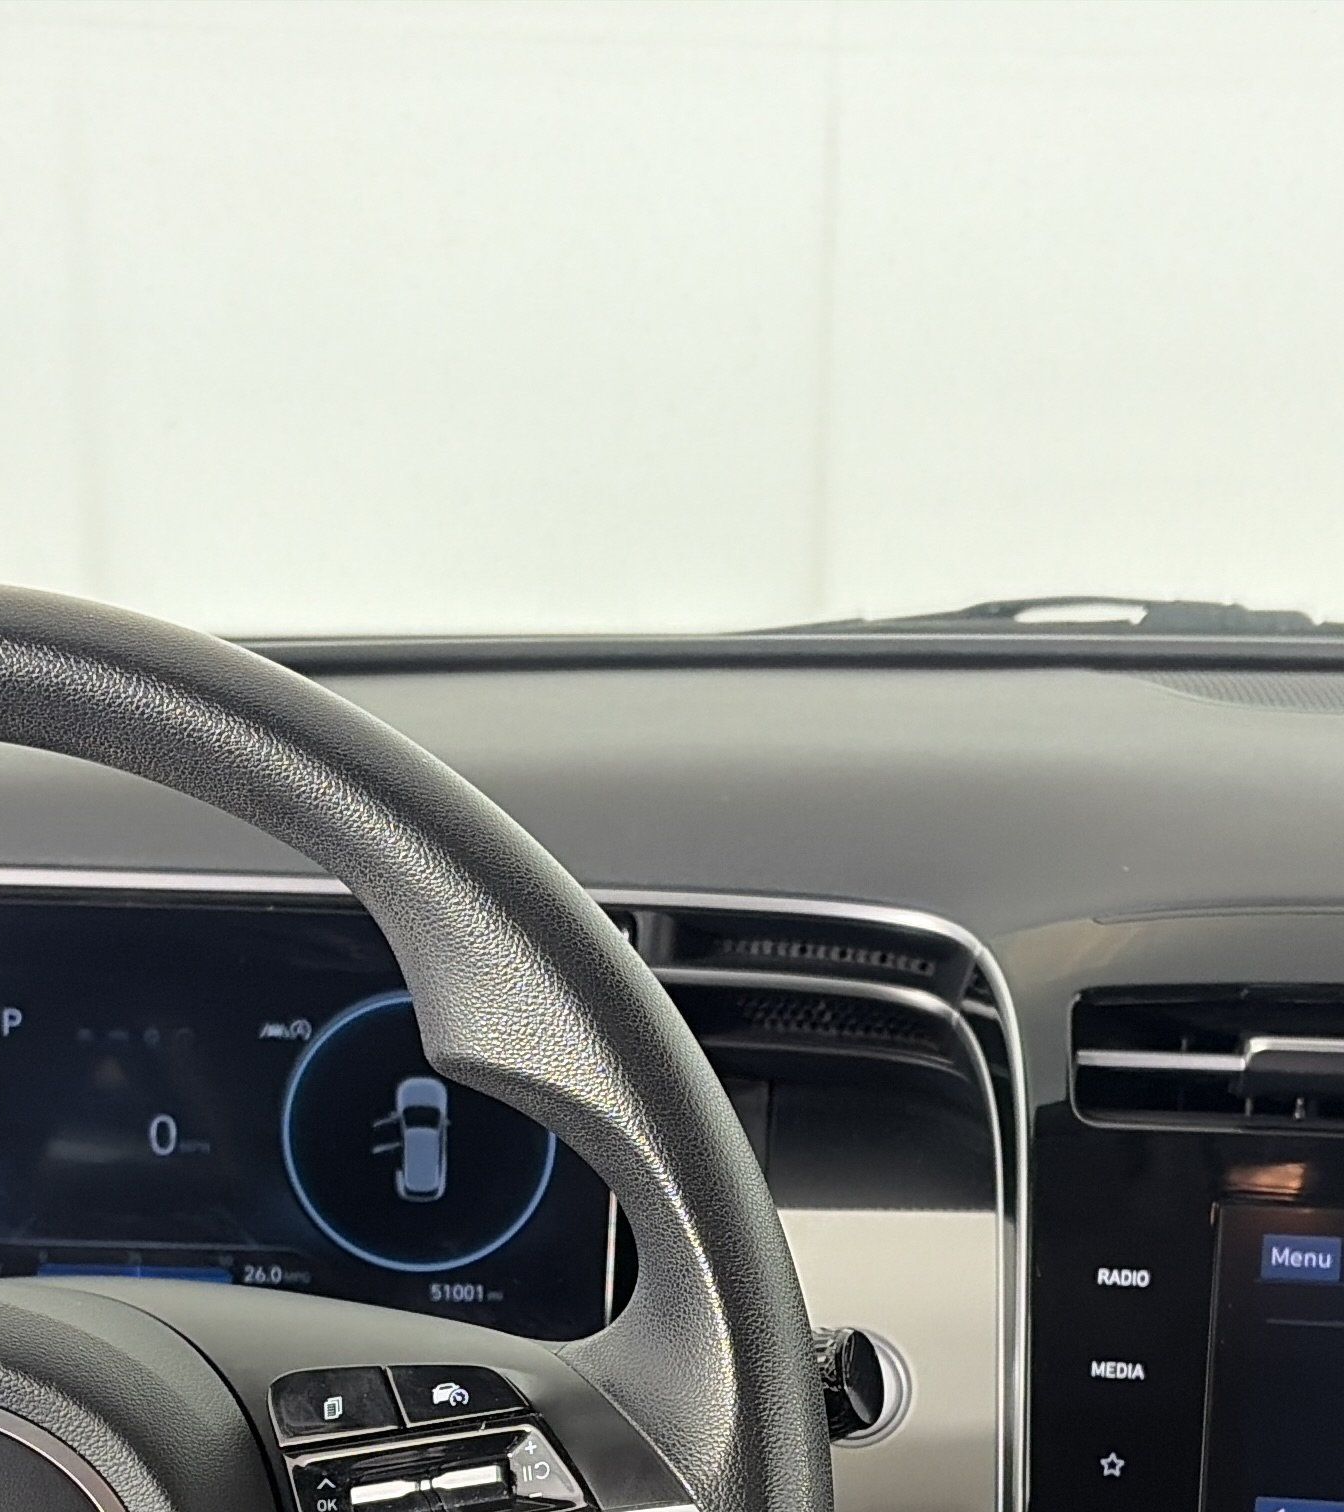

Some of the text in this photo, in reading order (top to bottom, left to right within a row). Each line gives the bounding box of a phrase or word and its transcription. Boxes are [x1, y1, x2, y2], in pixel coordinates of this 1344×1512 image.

[0, 1007, 23, 1036] P
[149, 1114, 178, 1156] 0
[1271, 1246, 1333, 1270] Menu
[244, 1264, 283, 1283] 26.0
[1097, 1267, 1150, 1288] RADIO
[430, 1284, 484, 1302] 51001
[1091, 1360, 1145, 1381] MEDIA
[316, 1499, 338, 1512] OK
